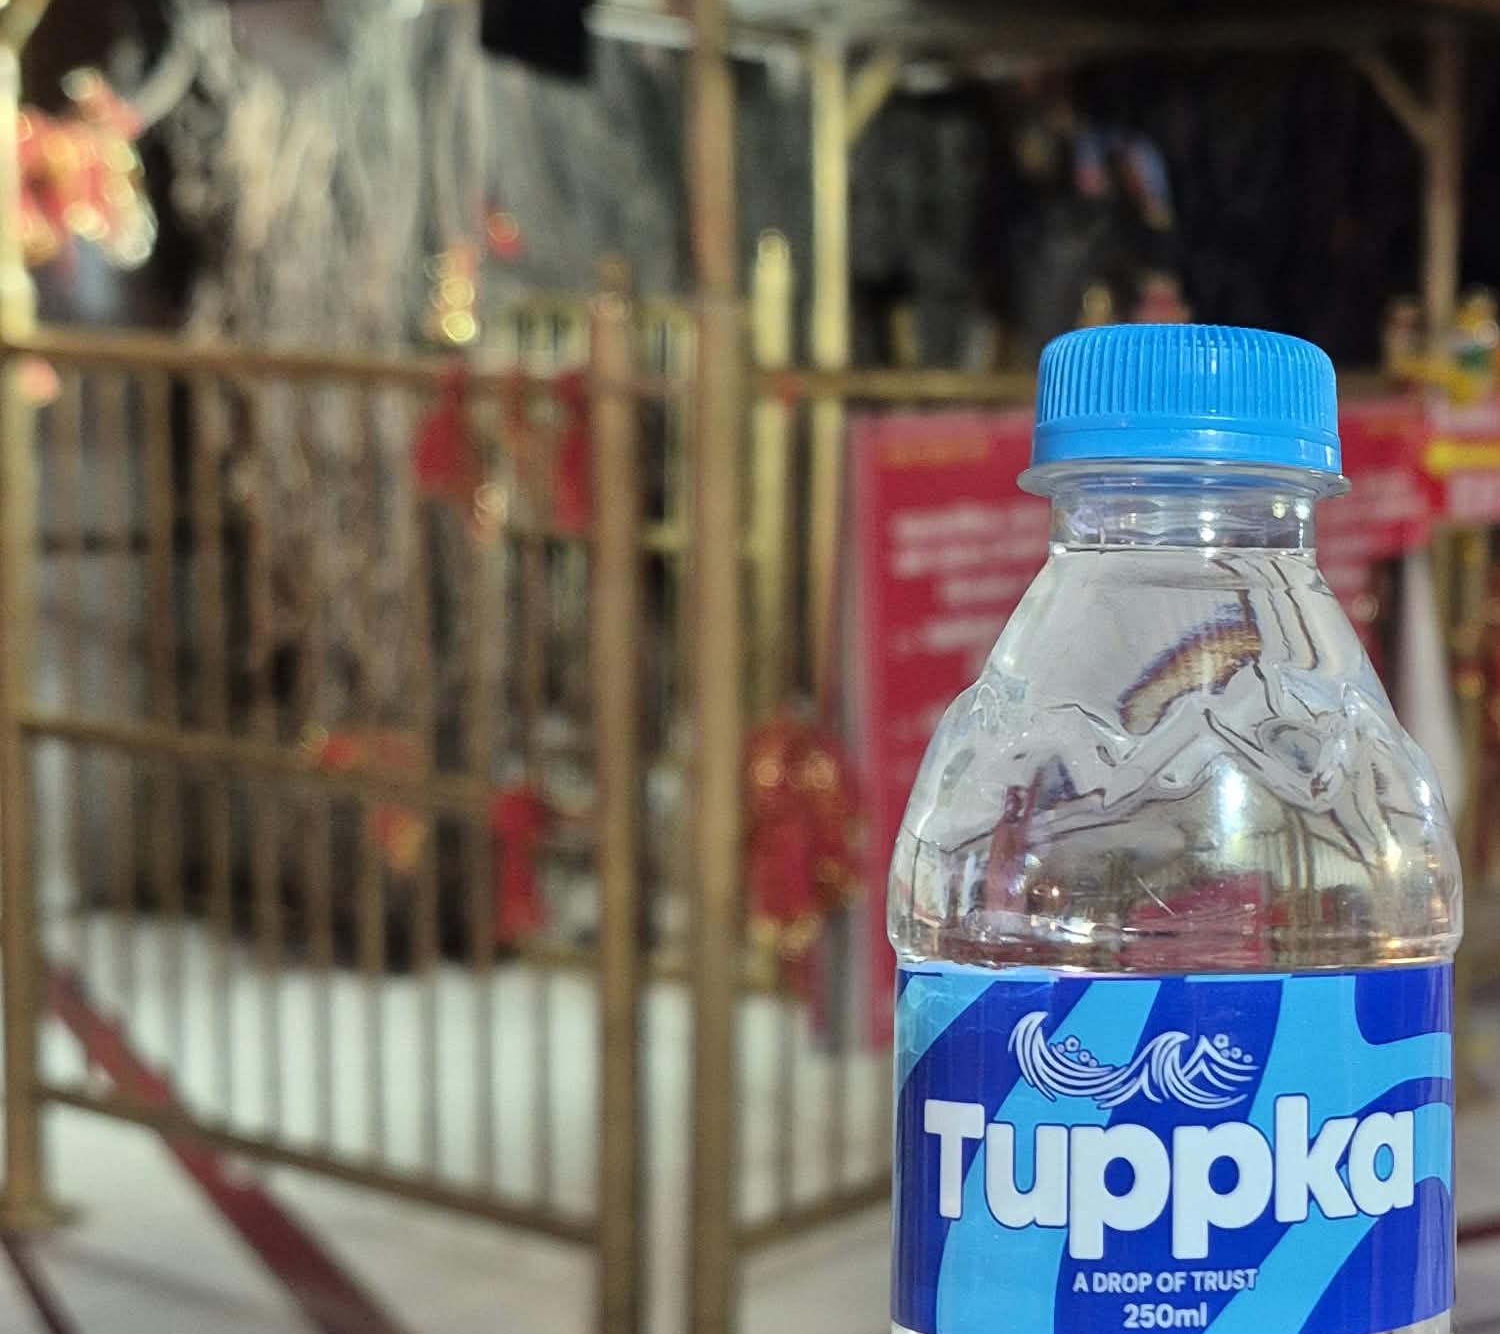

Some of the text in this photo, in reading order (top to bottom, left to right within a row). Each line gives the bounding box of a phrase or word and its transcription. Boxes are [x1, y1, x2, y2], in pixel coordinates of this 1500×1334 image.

[924, 1095, 1415, 1260] Tuppka
[1073, 1269, 1258, 1293] A DROP OF TRUST
[1123, 1302, 1207, 1329] 250ml
